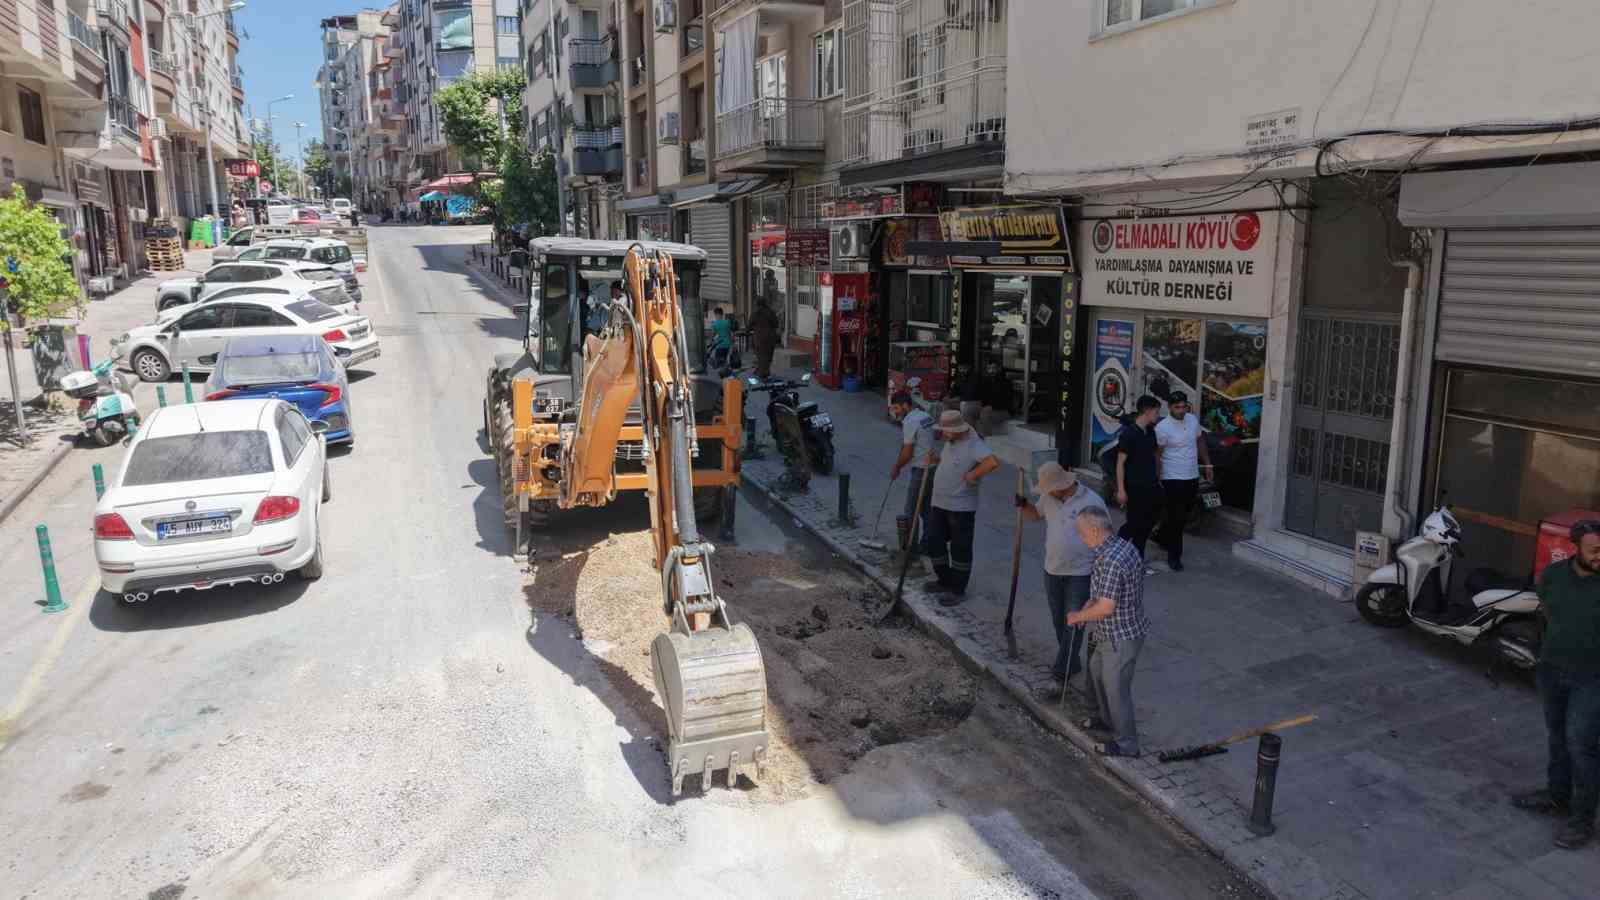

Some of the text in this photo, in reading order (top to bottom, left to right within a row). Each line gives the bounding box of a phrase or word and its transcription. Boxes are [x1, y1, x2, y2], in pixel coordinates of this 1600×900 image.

[1115, 216, 1228, 249] ELMADALI KÖYÜ
[1095, 258, 1254, 277] YARDIMLAŞMA DAYANIŞMA VE
[1106, 279, 1233, 301] KÜLTÜR DERNEĞİ
